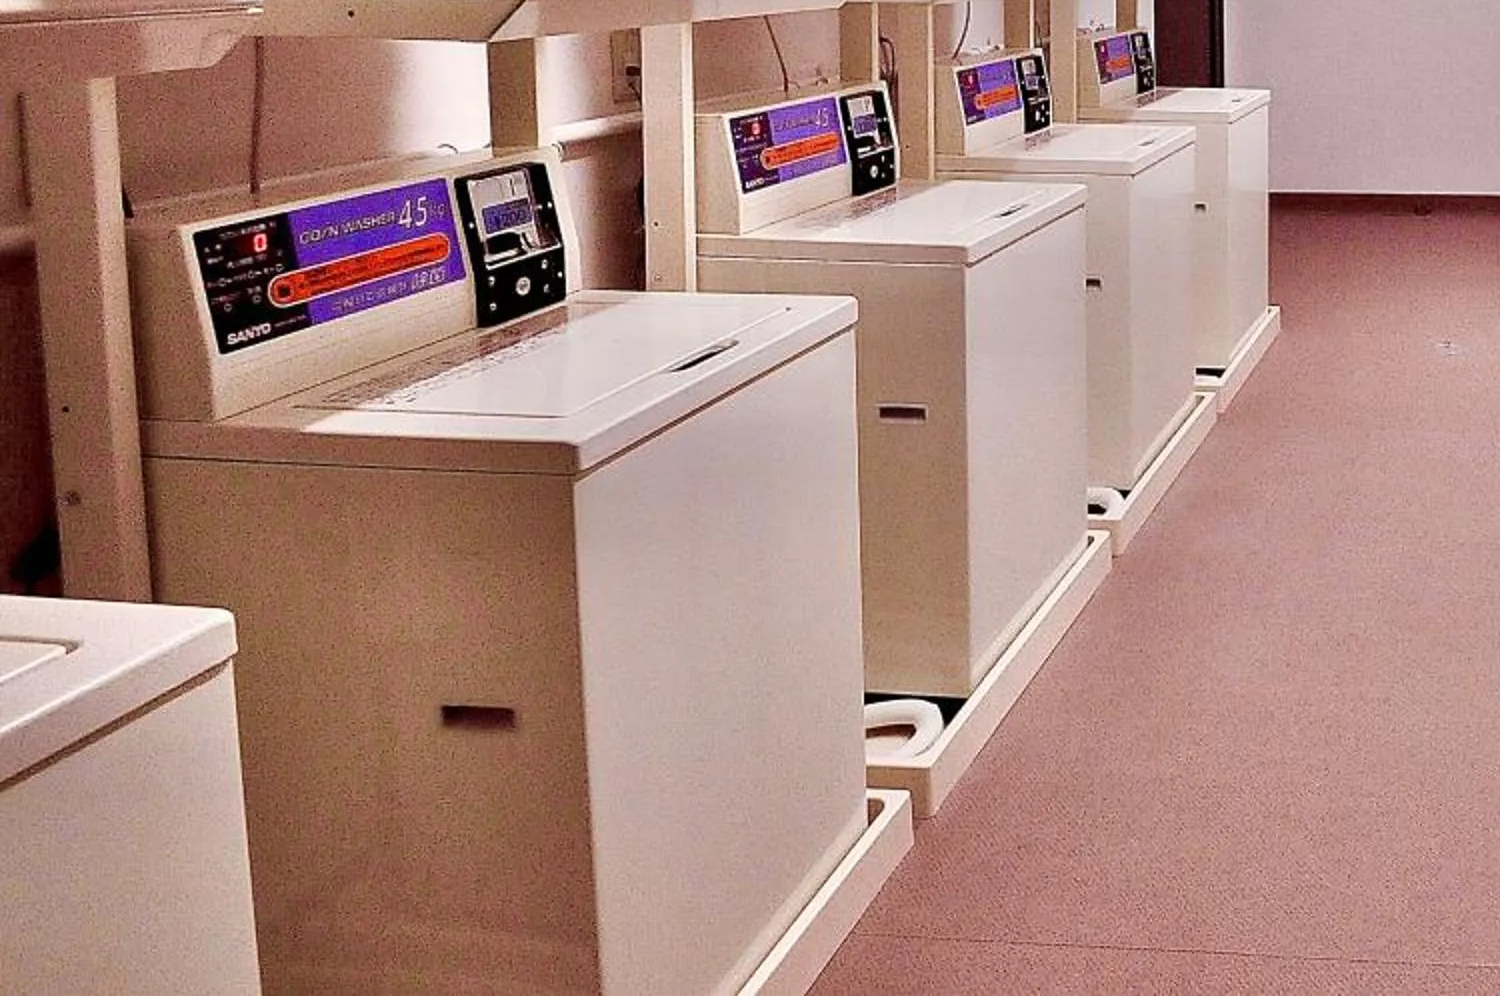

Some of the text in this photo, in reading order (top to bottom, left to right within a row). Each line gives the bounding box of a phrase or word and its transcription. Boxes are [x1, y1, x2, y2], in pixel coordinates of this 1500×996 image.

[341, 211, 395, 234] WASHER
[253, 233, 267, 252] 0
[227, 323, 271, 345] SANYO
